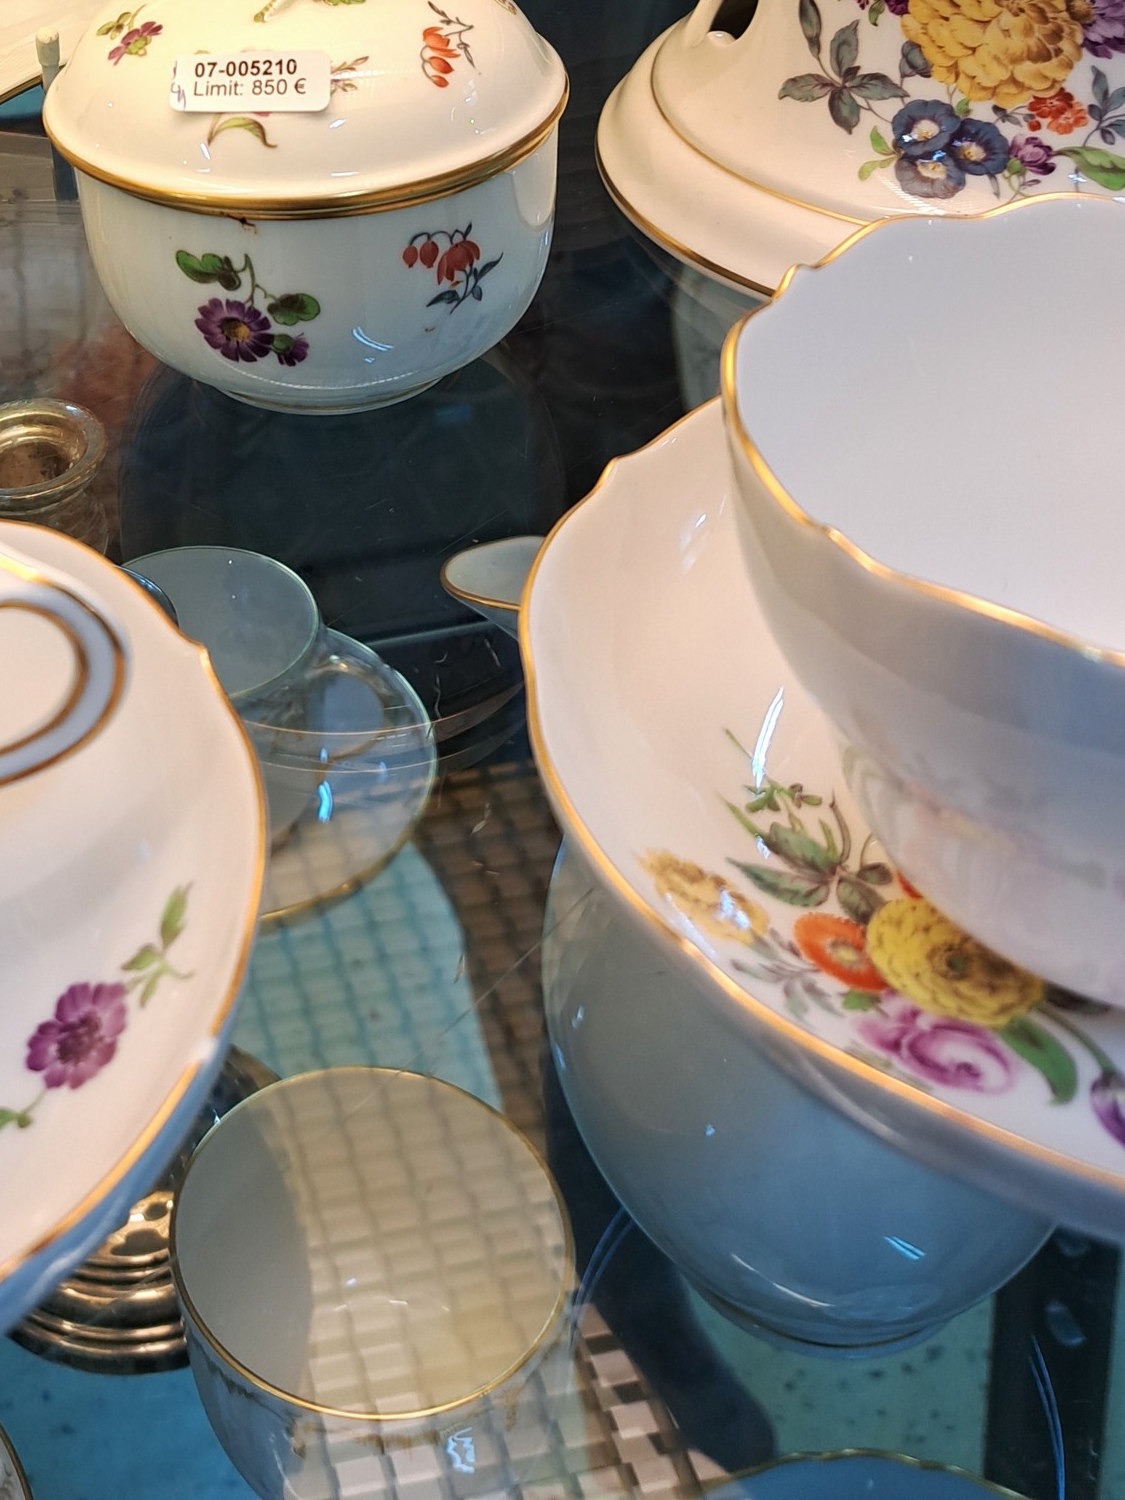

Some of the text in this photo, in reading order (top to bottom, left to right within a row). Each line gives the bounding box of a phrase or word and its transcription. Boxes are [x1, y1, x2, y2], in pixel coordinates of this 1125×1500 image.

[194, 58, 297, 78] 07-005210
[193, 77, 307, 96] Limit: 850 €
